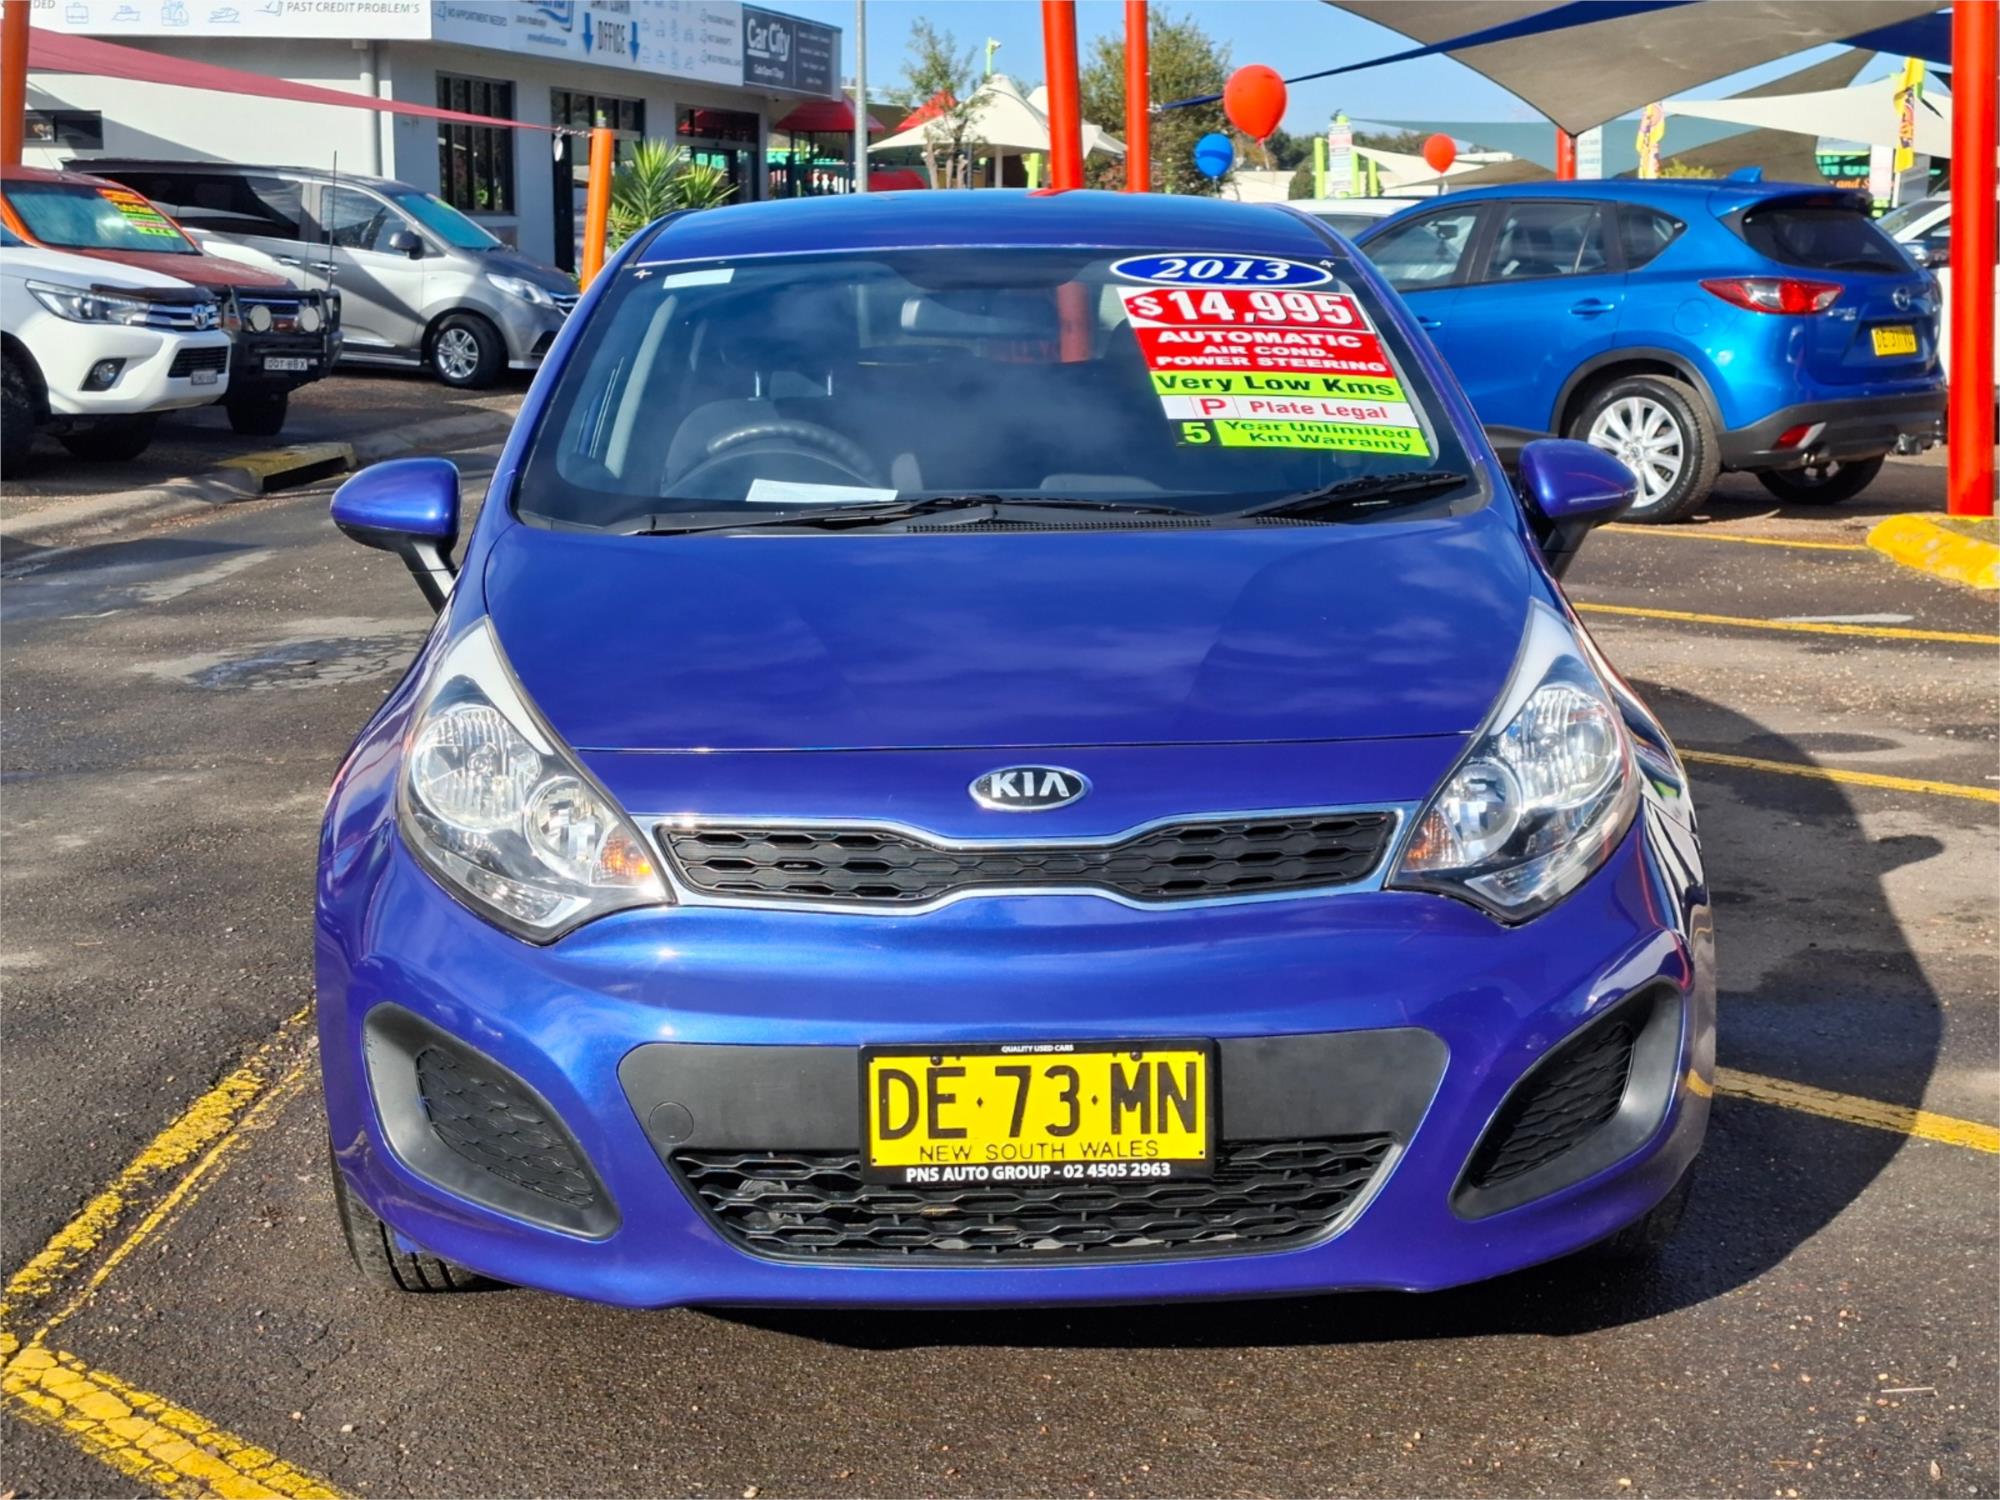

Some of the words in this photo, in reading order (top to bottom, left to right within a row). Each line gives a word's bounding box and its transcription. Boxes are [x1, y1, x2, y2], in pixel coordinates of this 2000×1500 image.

[286, 1, 313, 12] PAST
[316, 2, 355, 13] CREDIT
[357, 3, 420, 14] PROBLEM'S
[747, 18, 768, 50] Car
[768, 22, 791, 62] City
[1151, 259, 1291, 282] 2013
[1133, 290, 1354, 325] $14,995
[1157, 330, 1363, 348] AUTOMATIC
[1204, 345, 1249, 355] AIR
[1261, 346, 1335, 358] COND.
[1156, 355, 1252, 368] POWER
[1256, 357, 1388, 373] STEERING
[1155, 374, 1233, 392] Very
[1247, 375, 1311, 391] Low
[1322, 378, 1395, 396] Kms
[1199, 398, 1227, 416] P
[1249, 400, 1314, 416] Plate
[1323, 403, 1388, 420] Legal
[1182, 422, 1212, 444] 5
[1225, 420, 1293, 434] Year
[1296, 423, 1412, 440] Unlimited
[1249, 432, 1292, 443] Km
[1296, 434, 1412, 452] Warranty
[991, 771, 1070, 798] KIA
[1001, 1044, 1033, 1054] QUALITY
[1034, 1044, 1053, 1053] USED
[1054, 1044, 1074, 1053] CARS
[920, 1144, 973, 1162] NEW
[986, 1142, 1065, 1161] SOUTH
[1079, 1140, 1160, 1159] WALES
[906, 1167, 941, 1183] PNS
[943, 1167, 989, 1183] AUTO
[991, 1165, 1052, 1181] GROUP
[1062, 1164, 1085, 1180] 02
[1087, 1163, 1129, 1179] 4505
[1130, 1162, 1172, 1178] 2963
